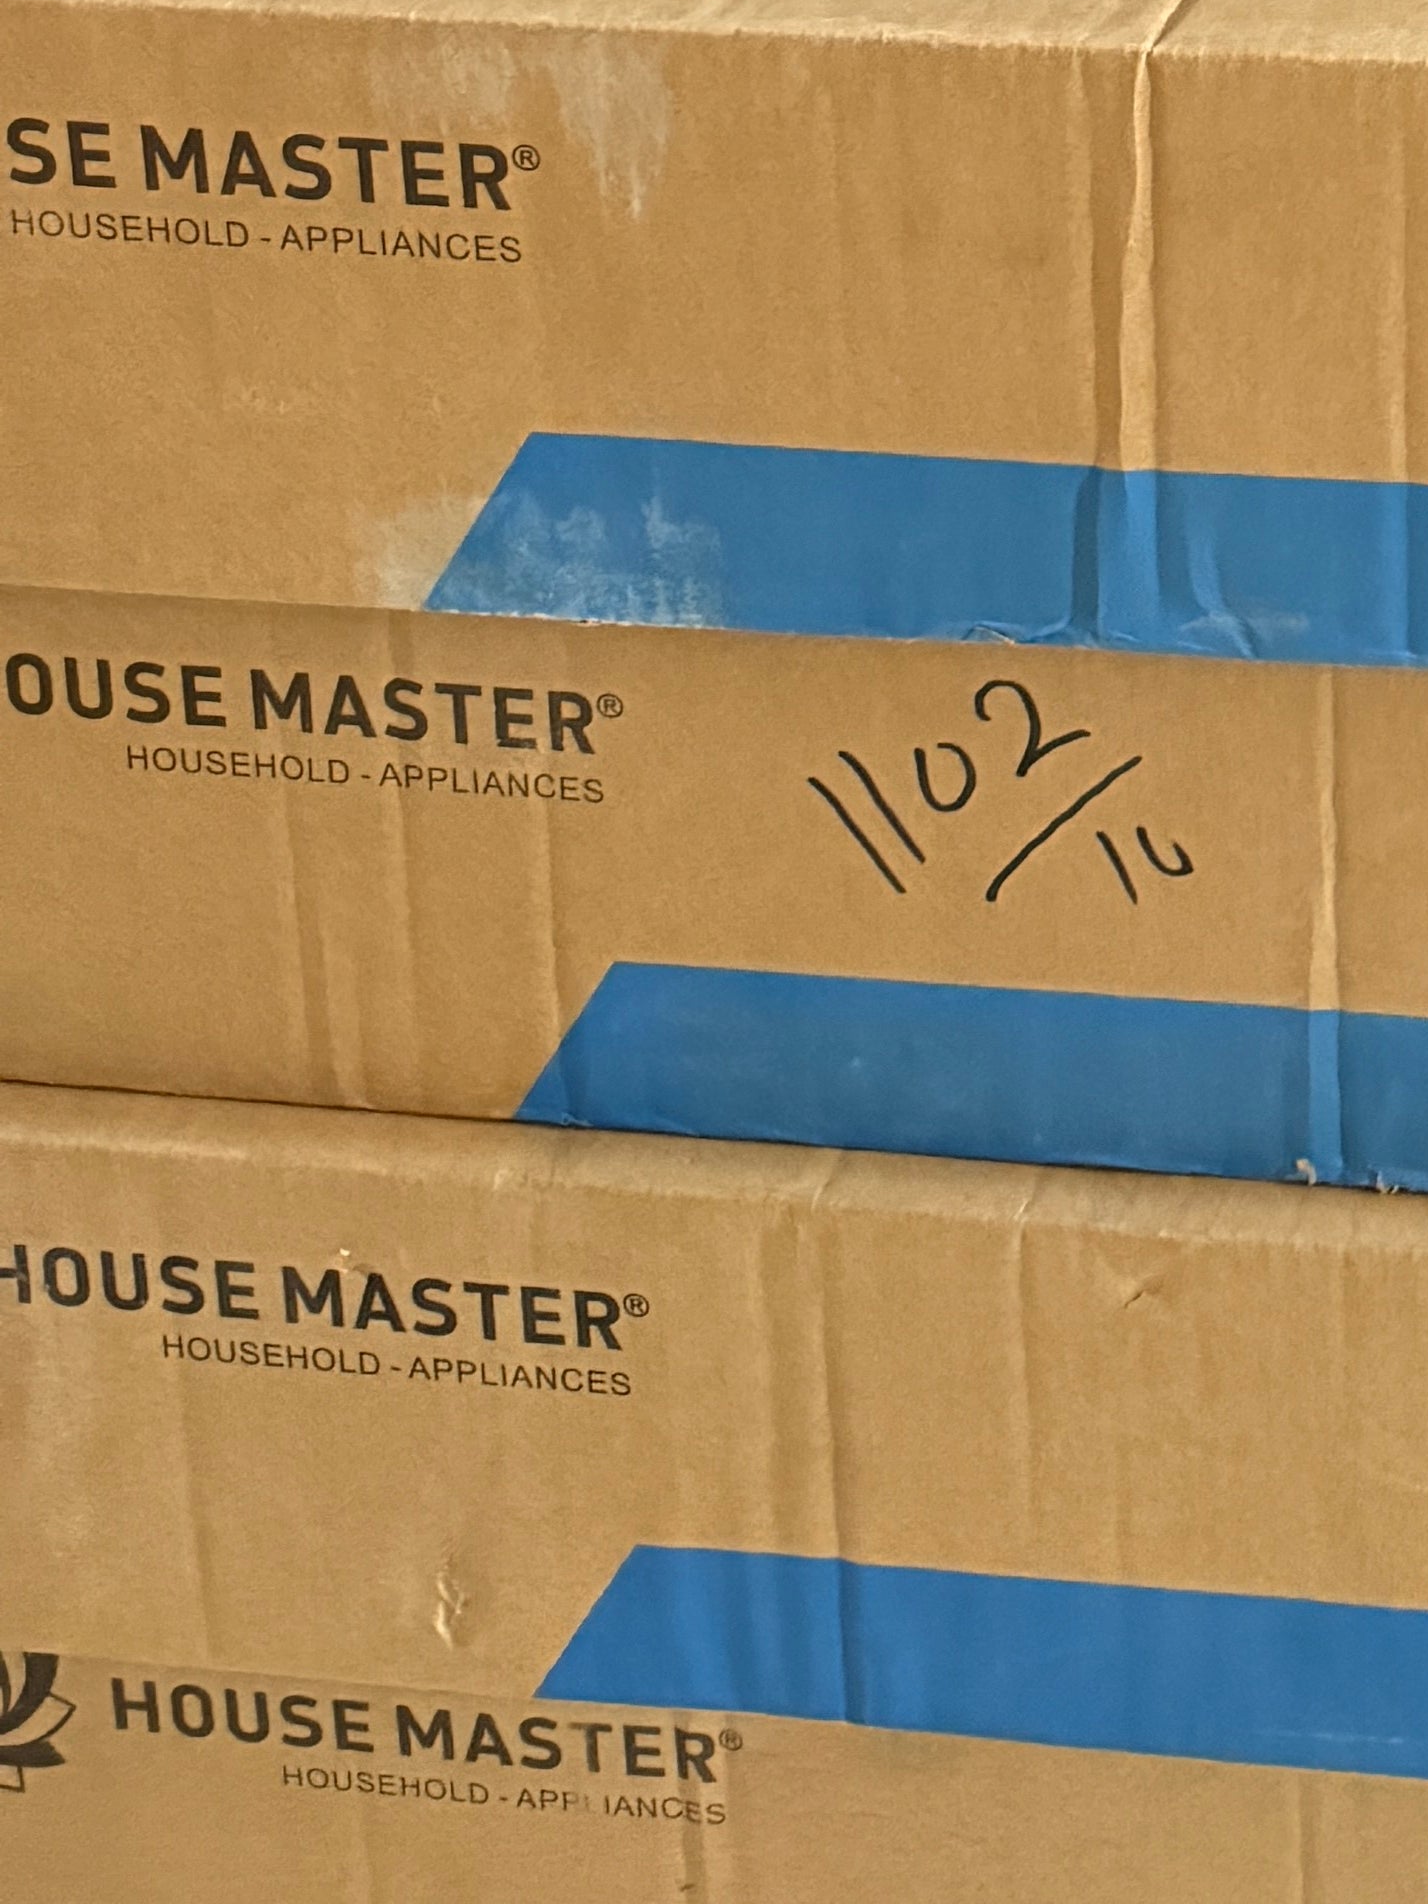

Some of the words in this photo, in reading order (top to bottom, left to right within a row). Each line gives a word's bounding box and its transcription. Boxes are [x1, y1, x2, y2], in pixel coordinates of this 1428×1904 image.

[4, 115, 117, 191] SE
[9, 208, 251, 251] HOUSEHOLD
[279, 222, 524, 265] APPLIANCES
[3, 650, 227, 732] OUSE
[125, 742, 352, 788] HOUSEHOLD
[378, 758, 607, 806] APPLIANCES
[160, 1332, 381, 1378] HOUSEHOLD
[407, 1355, 633, 1399] APPLIANCES
[108, 1676, 375, 1755] HOUSE
[281, 1762, 491, 1806] HOUSEHOLD
